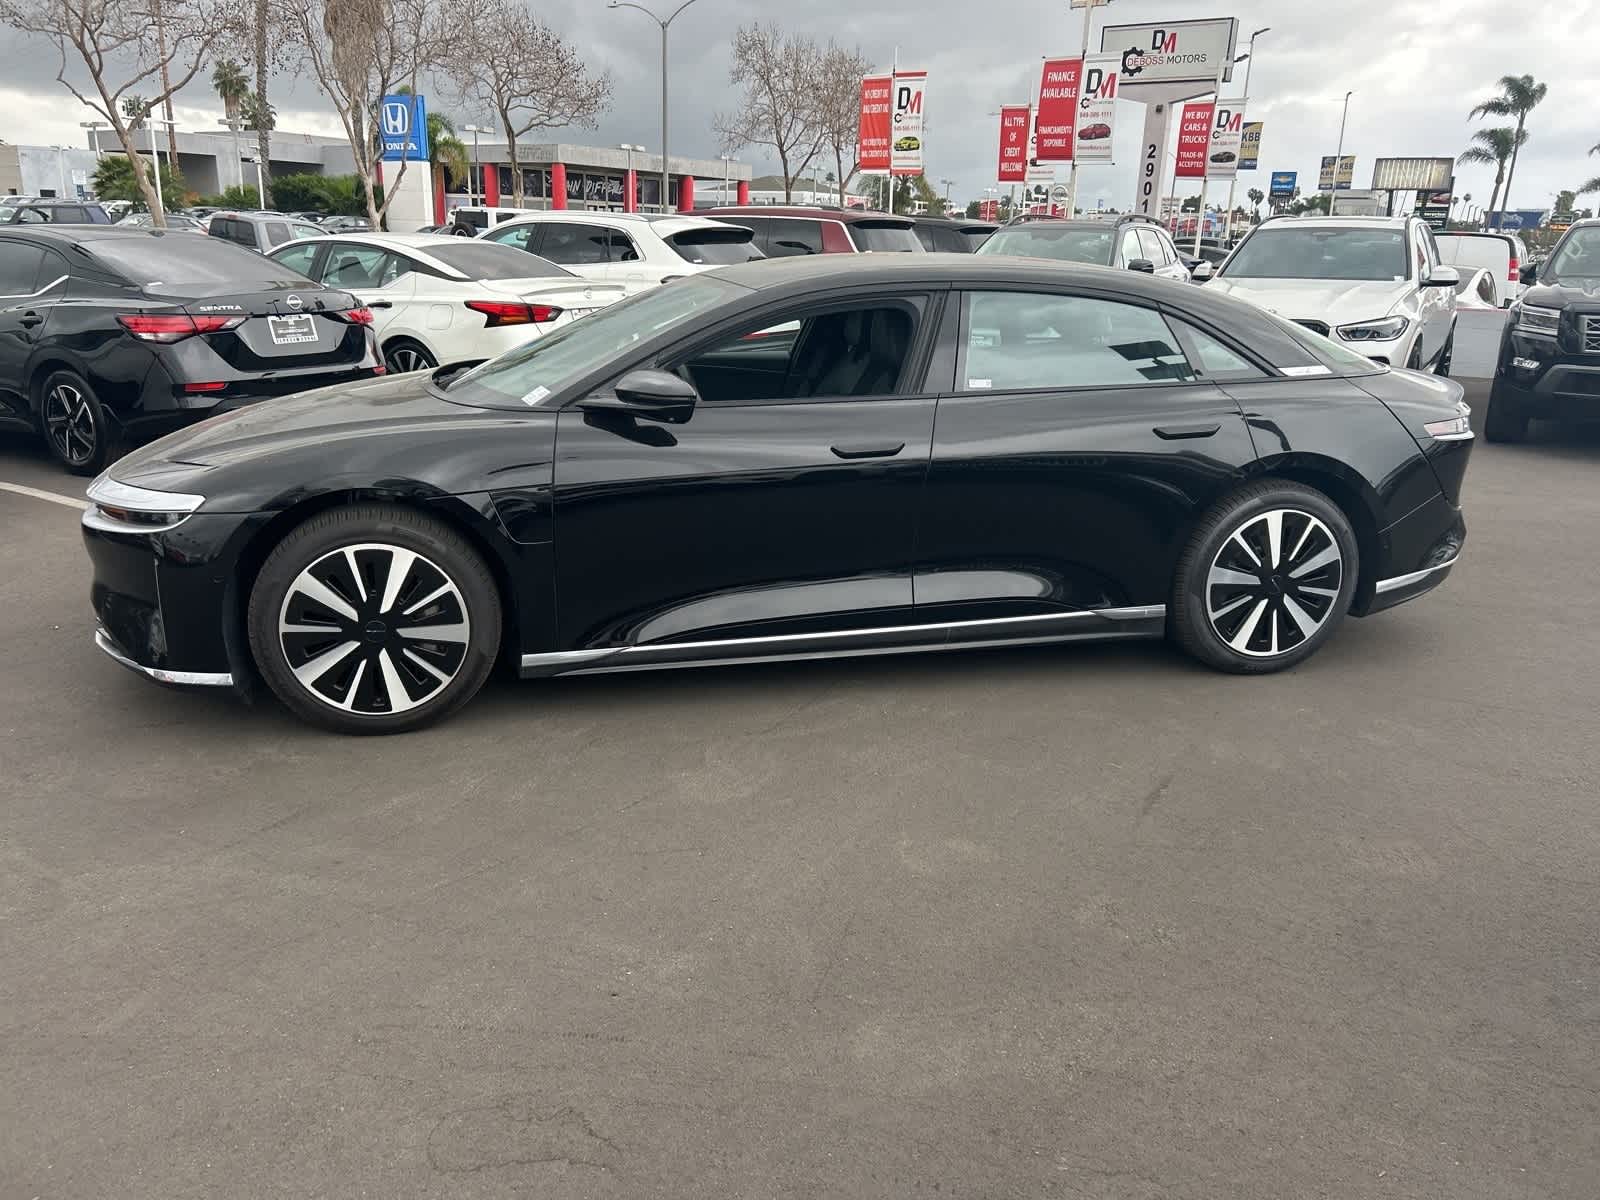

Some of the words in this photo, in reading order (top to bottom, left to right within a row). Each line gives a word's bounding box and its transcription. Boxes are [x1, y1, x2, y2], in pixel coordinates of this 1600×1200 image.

[1152, 29, 1177, 54] DM
[1127, 55, 1164, 66] DEBOSS
[1166, 53, 1207, 64] MOTORS
[1047, 71, 1076, 83] FINANCE
[1085, 68, 1117, 99] DM
[1041, 87, 1077, 98] AVAILABLE
[897, 86, 923, 114] DM
[1185, 111, 1196, 119] WE
[1196, 111, 1210, 119] BUY
[1216, 109, 1242, 132] DM
[1004, 117, 1013, 127] ALL
[1014, 116, 1025, 127] TYPE
[1183, 122, 1201, 131] CARS
[1201, 123, 1208, 131] &
[1009, 132, 1017, 142] OF
[1181, 135, 1207, 144] TRUCKS
[1241, 131, 1260, 142] KBB
[1004, 147, 1020, 157] CREDIT
[1000, 162, 1023, 172] WELCOME
[1141, 143, 1157, 214] 2901
